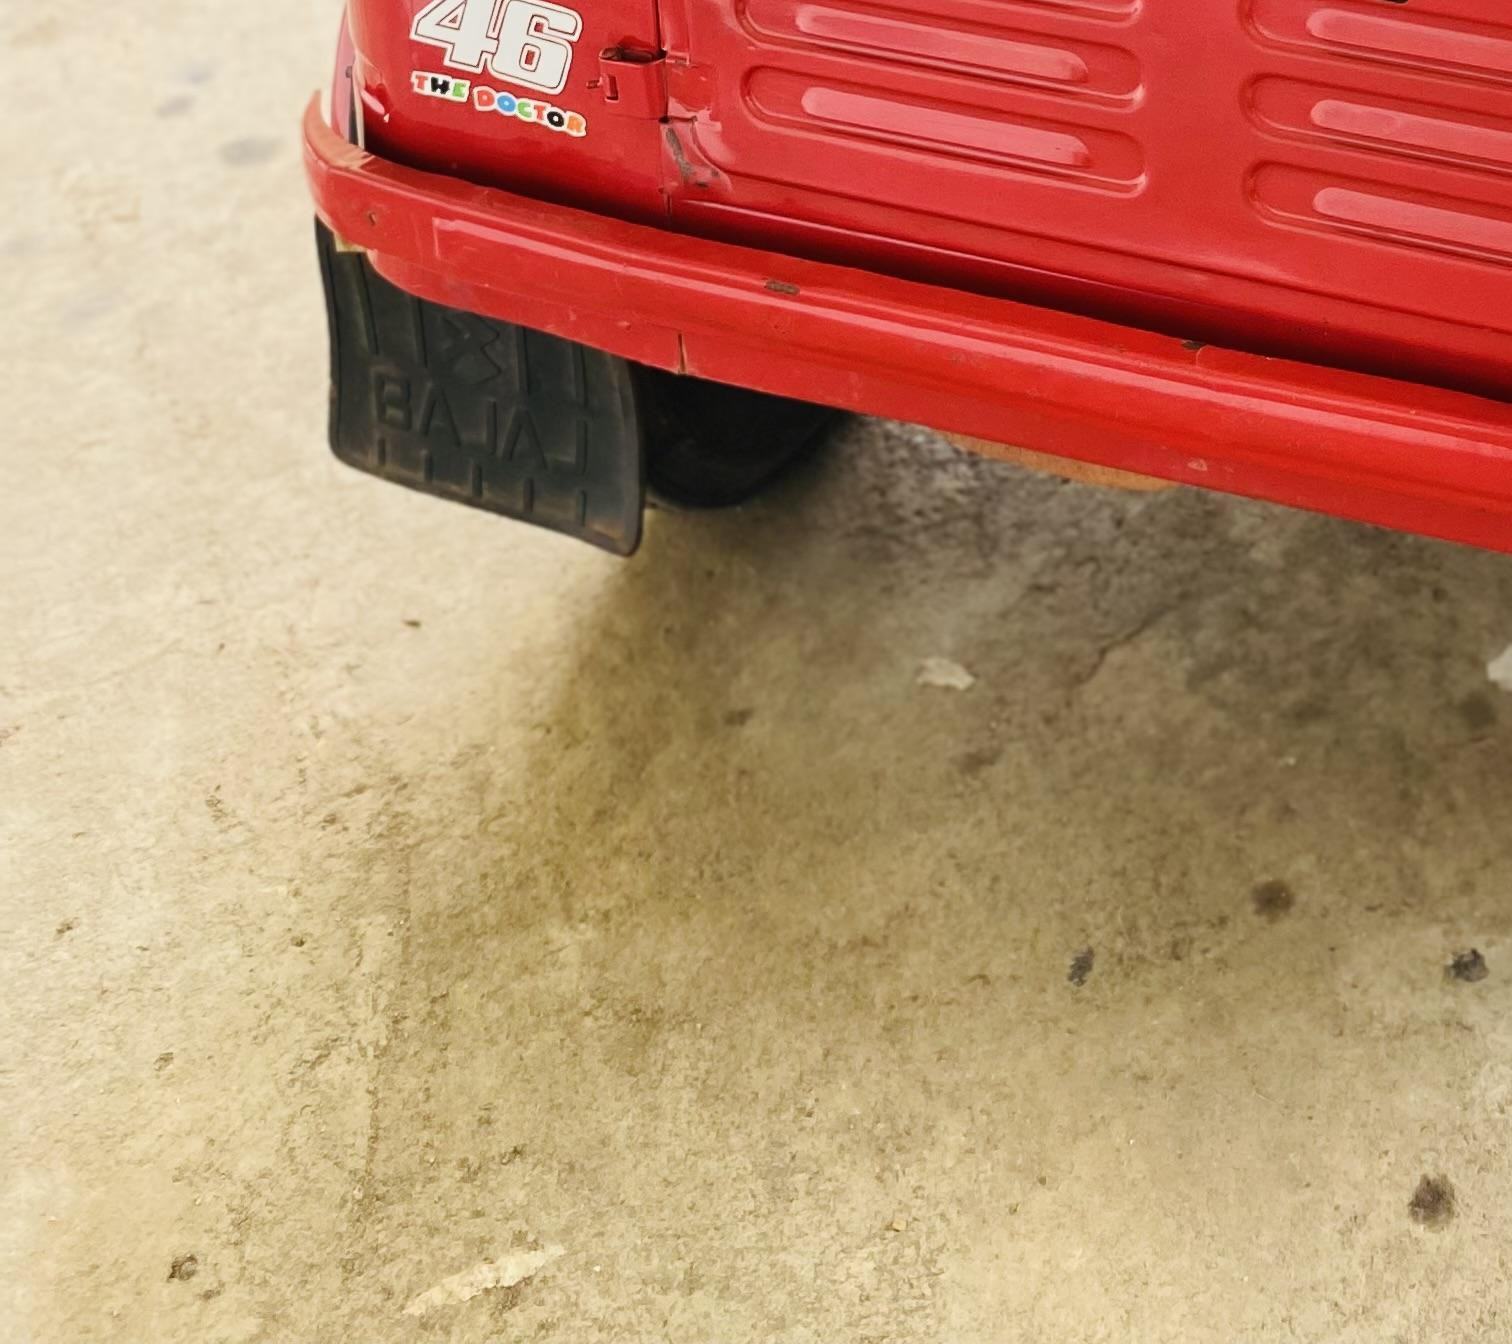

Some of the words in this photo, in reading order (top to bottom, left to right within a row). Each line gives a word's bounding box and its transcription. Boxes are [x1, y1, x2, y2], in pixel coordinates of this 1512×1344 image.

[411, 71, 471, 103] THE
[473, 86, 587, 138] DOCTOR
[369, 363, 588, 478] BAJAJ
